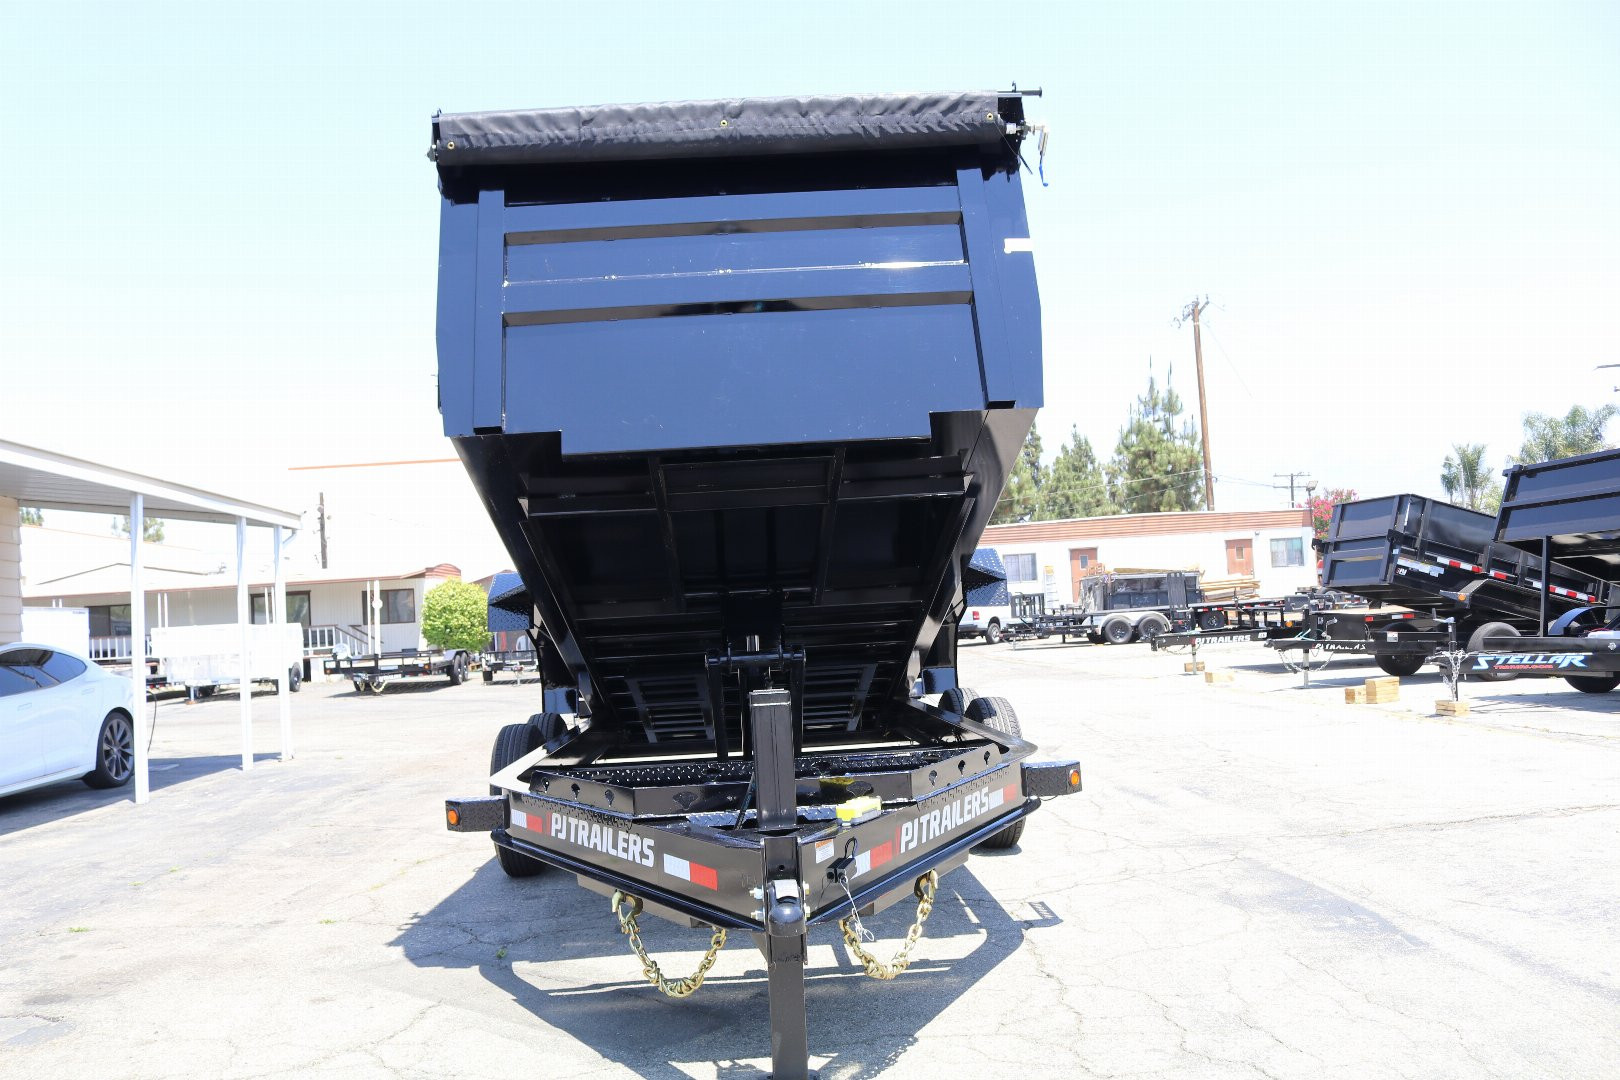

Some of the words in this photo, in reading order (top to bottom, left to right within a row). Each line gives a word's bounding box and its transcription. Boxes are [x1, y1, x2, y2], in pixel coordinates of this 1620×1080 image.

[1203, 635, 1251, 644] TRAILERS
[1472, 655, 1588, 669] STELLAR
[900, 817, 919, 854] PJ
[919, 786, 989, 844] TRAILERS
[551, 812, 567, 840] PJ
[568, 816, 655, 868] TRAILERS
